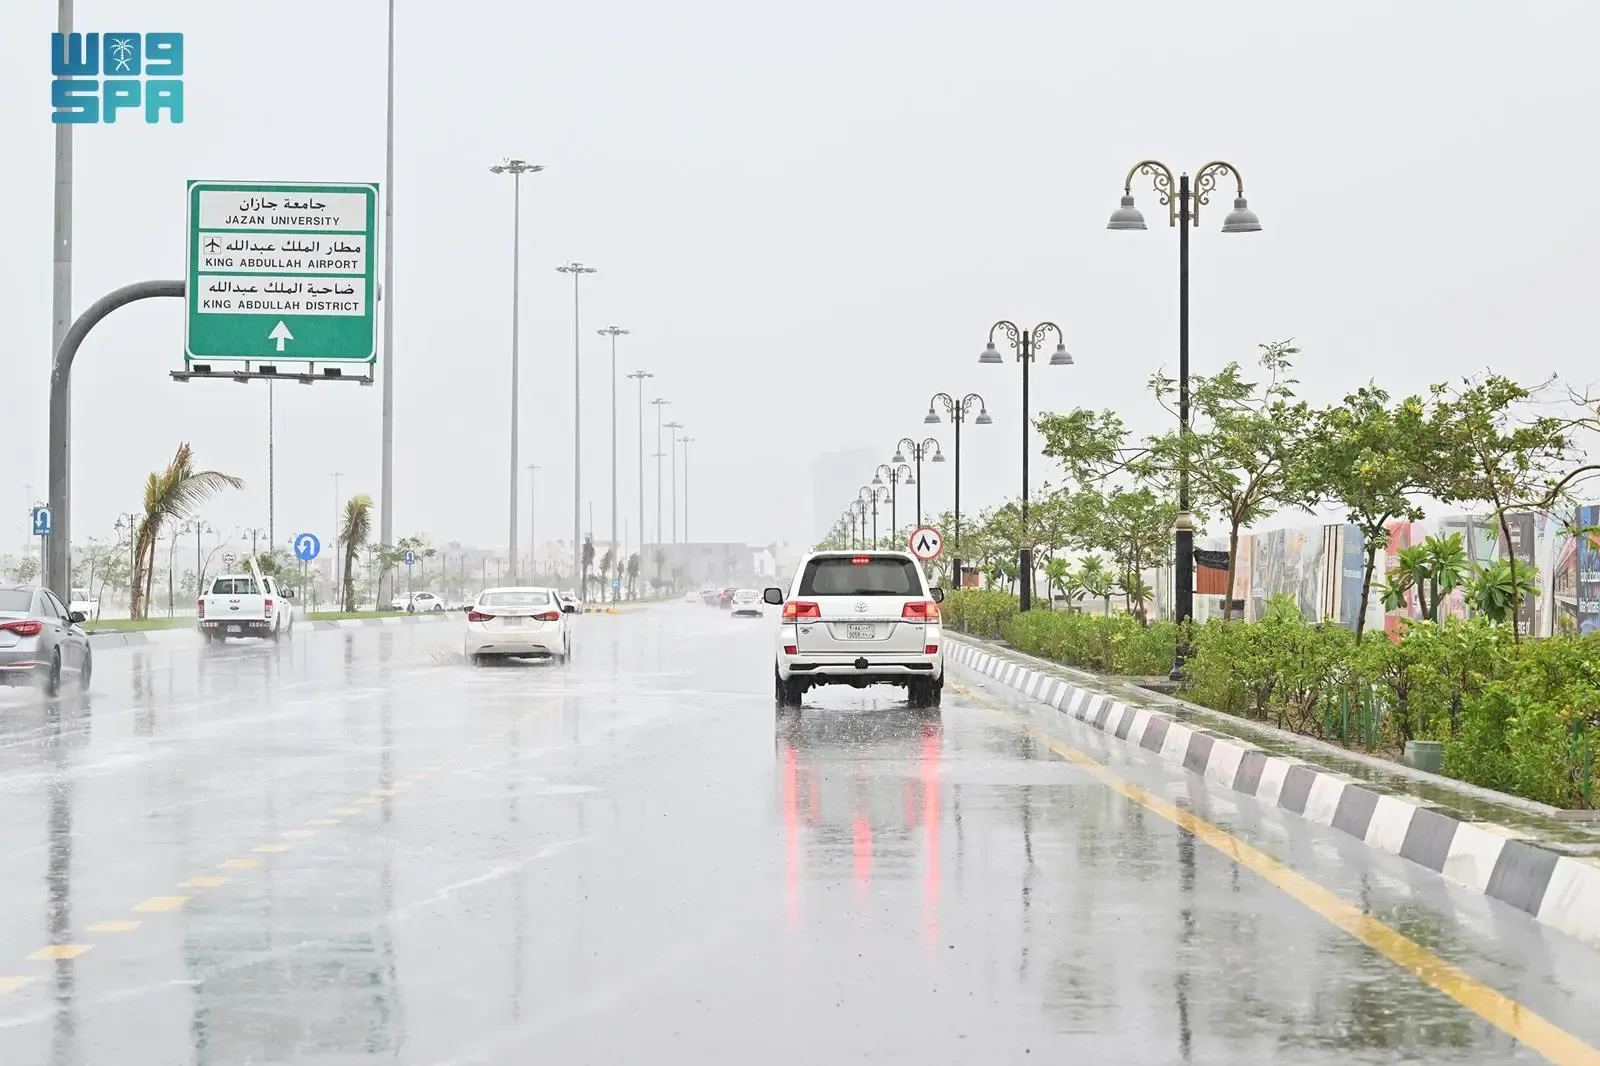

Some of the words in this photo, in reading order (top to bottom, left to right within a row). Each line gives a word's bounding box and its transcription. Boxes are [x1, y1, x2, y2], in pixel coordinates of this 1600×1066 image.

[239, 197, 278, 212] جازان
[283, 197, 326, 212] جامعة
[225, 215, 265, 225] JAZAN
[271, 216, 340, 226] UNIVERSITY
[225, 239, 276, 255] عبدالله
[281, 240, 320, 253] الملك
[325, 241, 361, 256] مطار
[205, 258, 233, 268] KING
[240, 258, 302, 268] ABDULLAH
[307, 260, 359, 269] AIRPORT
[208, 281, 258, 296] عبدالله
[263, 283, 303, 295] الملك
[307, 283, 355, 297] ضاحية
[203, 299, 231, 309] KING
[238, 300, 300, 310] ABDULLAH
[305, 301, 360, 311] DISTRICT
[917, 535, 938, 552] ٨٠
